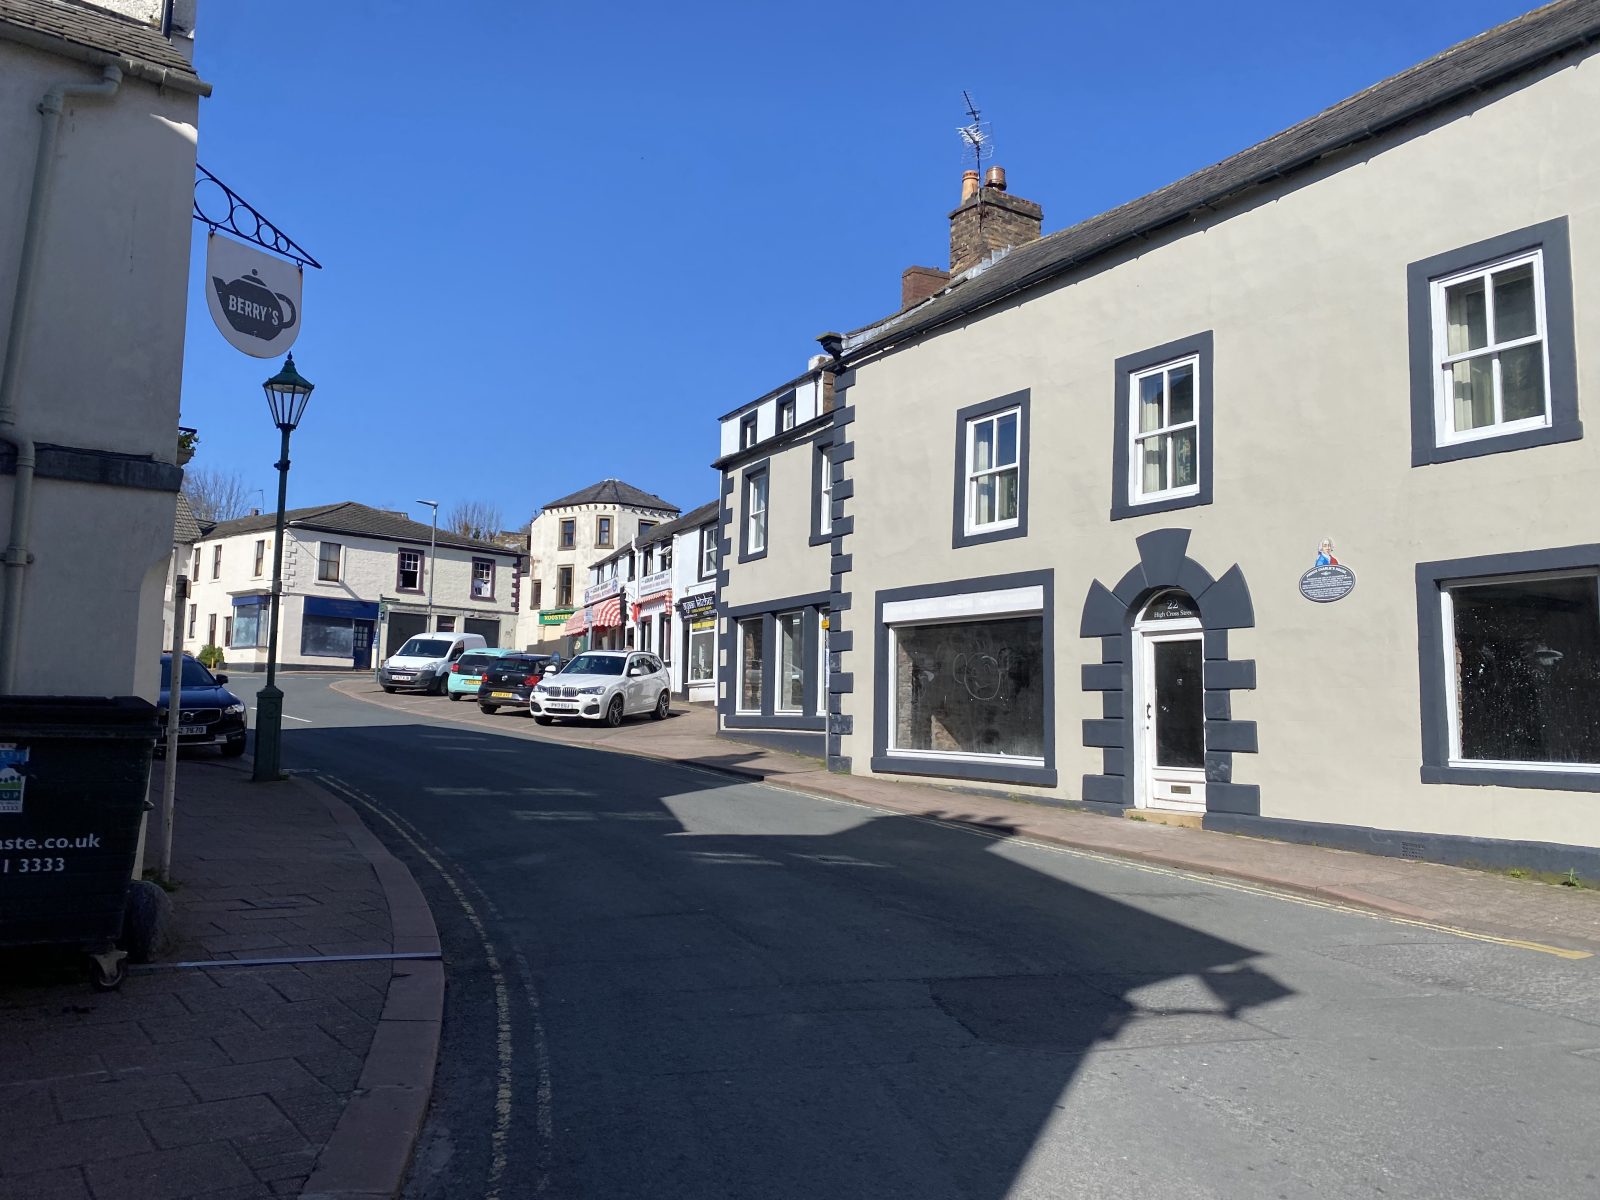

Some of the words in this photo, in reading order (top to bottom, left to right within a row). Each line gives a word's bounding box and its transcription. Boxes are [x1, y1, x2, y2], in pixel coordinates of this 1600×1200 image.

[228, 294, 279, 326] BERRY'S
[1167, 599, 1179, 609] 22
[18, 857, 65, 873] 3333
